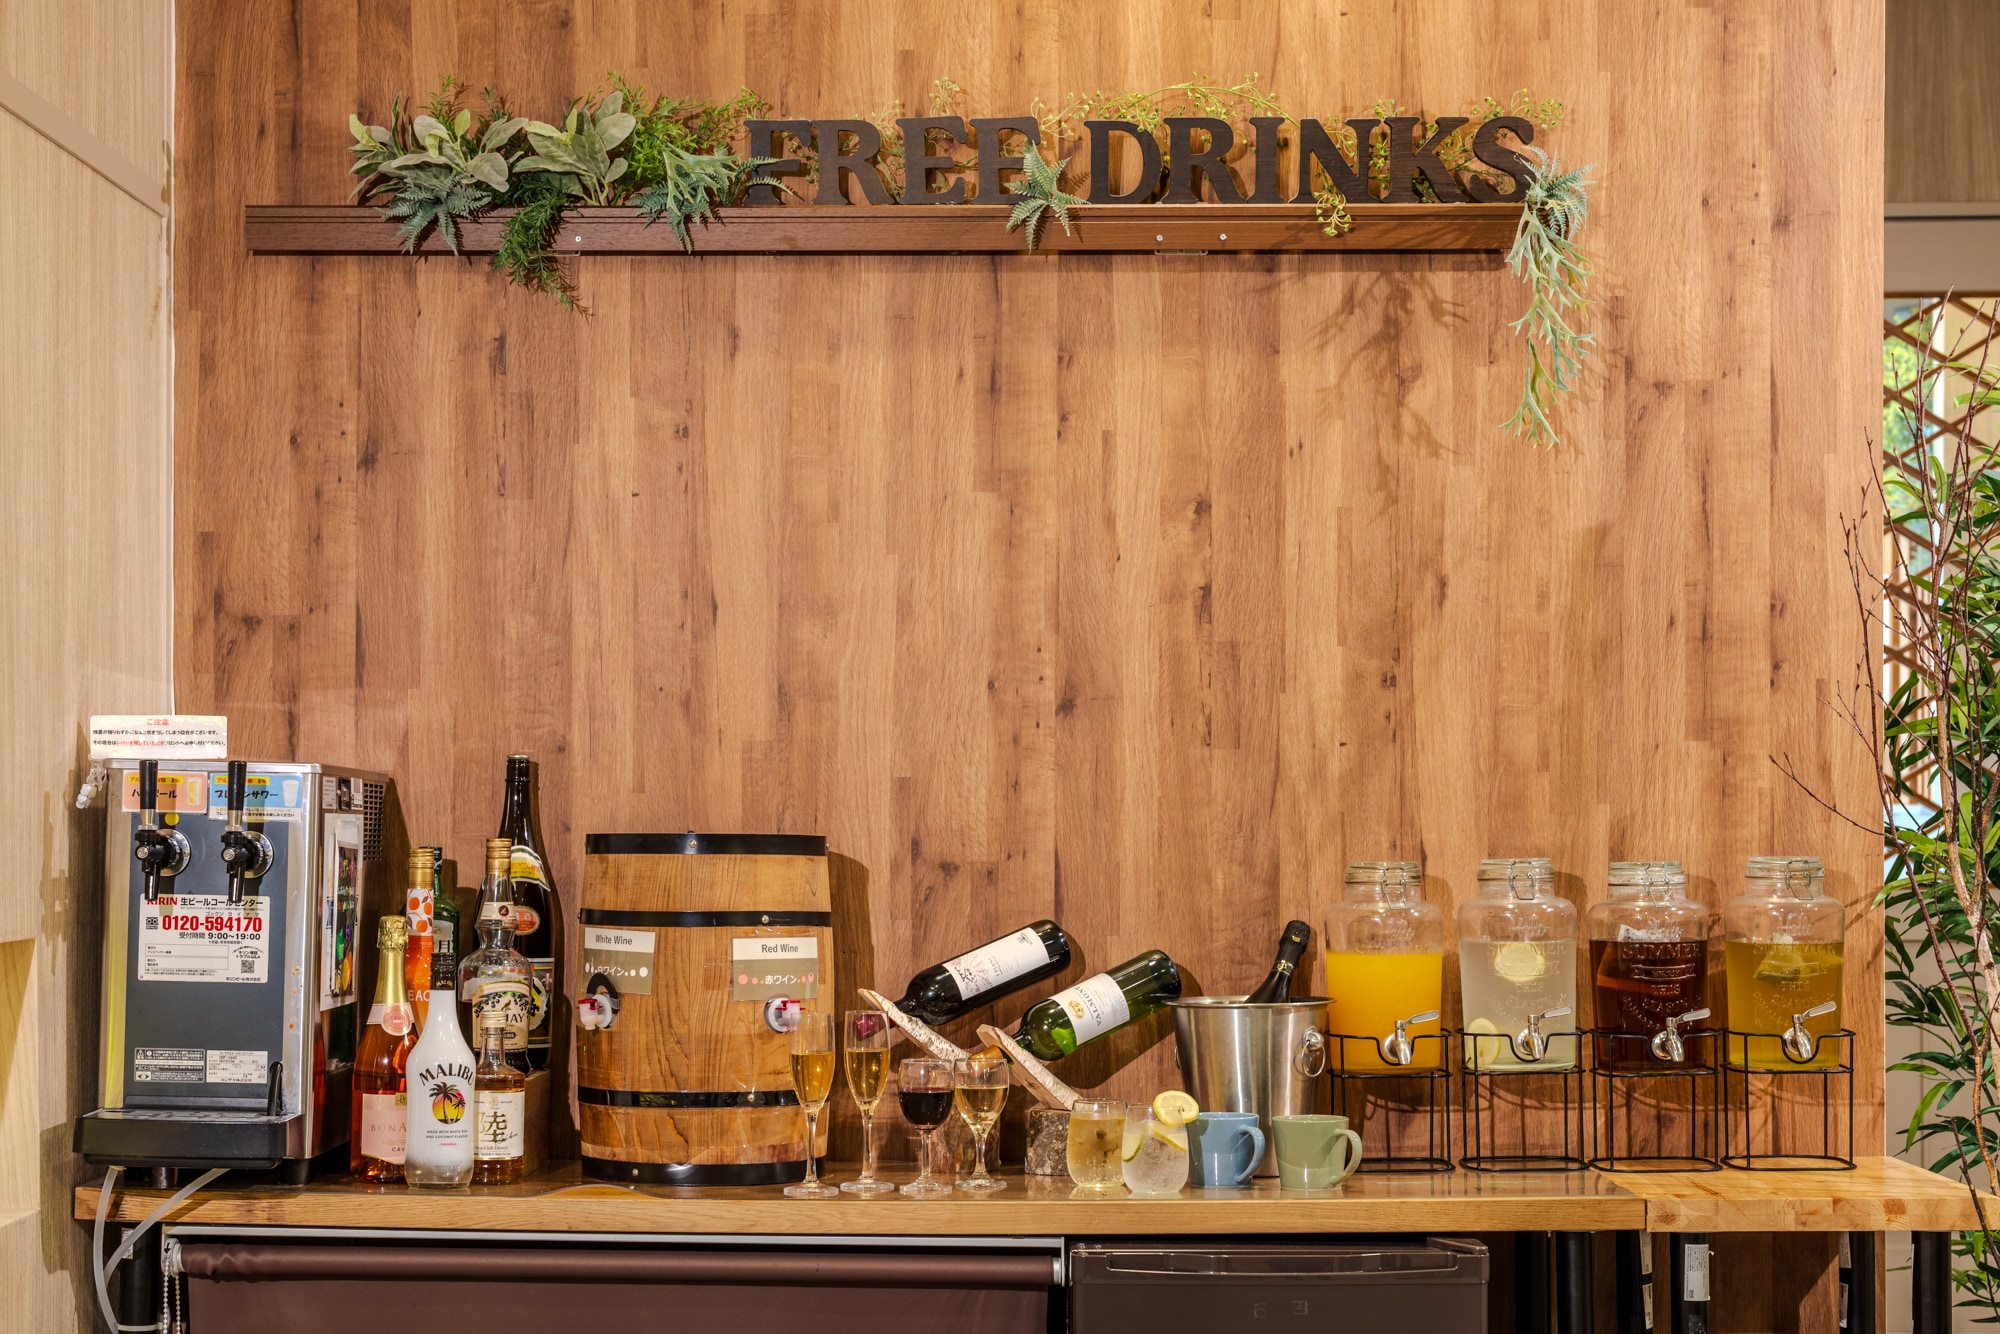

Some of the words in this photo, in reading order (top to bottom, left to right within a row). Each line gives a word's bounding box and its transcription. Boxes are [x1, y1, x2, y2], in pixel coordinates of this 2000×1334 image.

[743, 116, 1041, 205] FREE
[1083, 116, 1537, 205] DRINKS
[162, 914, 263, 932] 0120-594170
[595, 934, 612, 945] White
[613, 935, 633, 945] Wine
[761, 943, 778, 953] Red
[780, 943, 799, 953] Wine
[597, 966, 625, 977] 白ワイン
[765, 975, 797, 985] 赤ワイン
[408, 989, 430, 1001] EAC
[1074, 986, 1102, 1026] VALMONT
[419, 1062, 475, 1087] MALIBU
[371, 1121, 407, 1132] BONA
